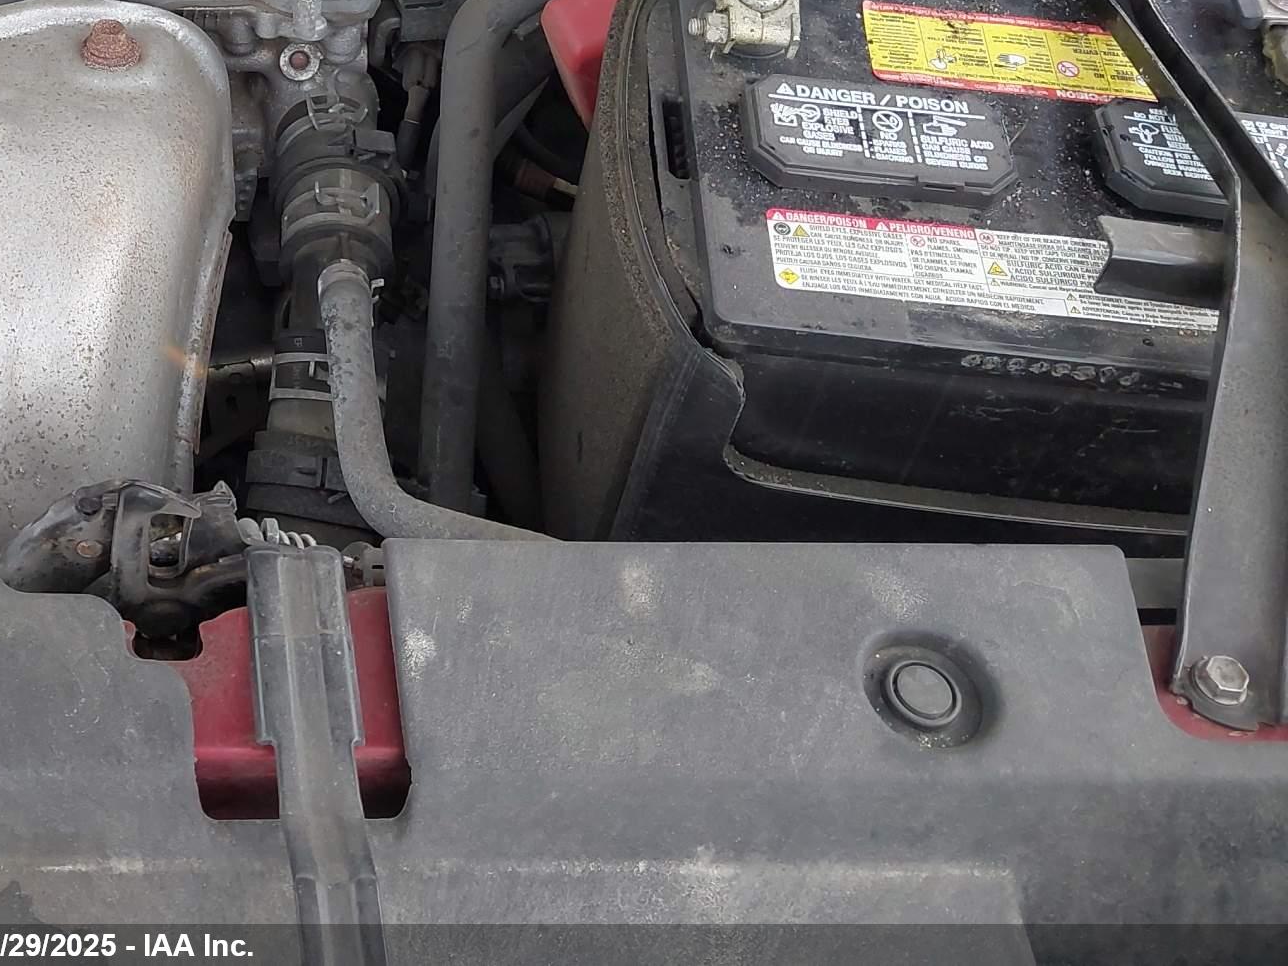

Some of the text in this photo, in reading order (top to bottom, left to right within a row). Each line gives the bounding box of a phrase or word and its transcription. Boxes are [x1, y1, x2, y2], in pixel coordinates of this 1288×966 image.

[795, 84, 968, 116] DANGER / POISON
[822, 107, 858, 119] SHIELD
[1134, 111, 1164, 122] DO NOT
[824, 115, 850, 126] EYES
[802, 120, 854, 134] EXPLOSIVE
[802, 129, 834, 141] GASES
[880, 130, 897, 140] NO
[779, 135, 862, 152] CAN CAUSE BLINDNESS
[872, 138, 906, 149] SPARKS
[920, 134, 994, 150] SULFURIC ACID
[874, 145, 907, 156] FLAMES
[921, 142, 971, 155] CAN CAUSE
[1138, 146, 1172, 157] CAUTION
[876, 152, 914, 163] SMOKING
[922, 149, 987, 164] BLINDNESS OR
[925, 156, 958, 167] SEVERE
[786, 211, 974, 240] DANGER/POISON PELIGRO/VENENO
[849, 228, 880, 237] EXPLOSIVE
[952, 247, 978, 255] SMOKING
[847, 256, 868, 264] GASES
[1006, 259, 1099, 275] SULFURIC ACID CAN CAUS
[834, 270, 874, 280] IMMEDIATELY
[925, 280, 952, 288] MEDICAL
[1039, 269, 1086, 280] SULFURIQUE
[1036, 276, 1078, 287] SULFURICO
